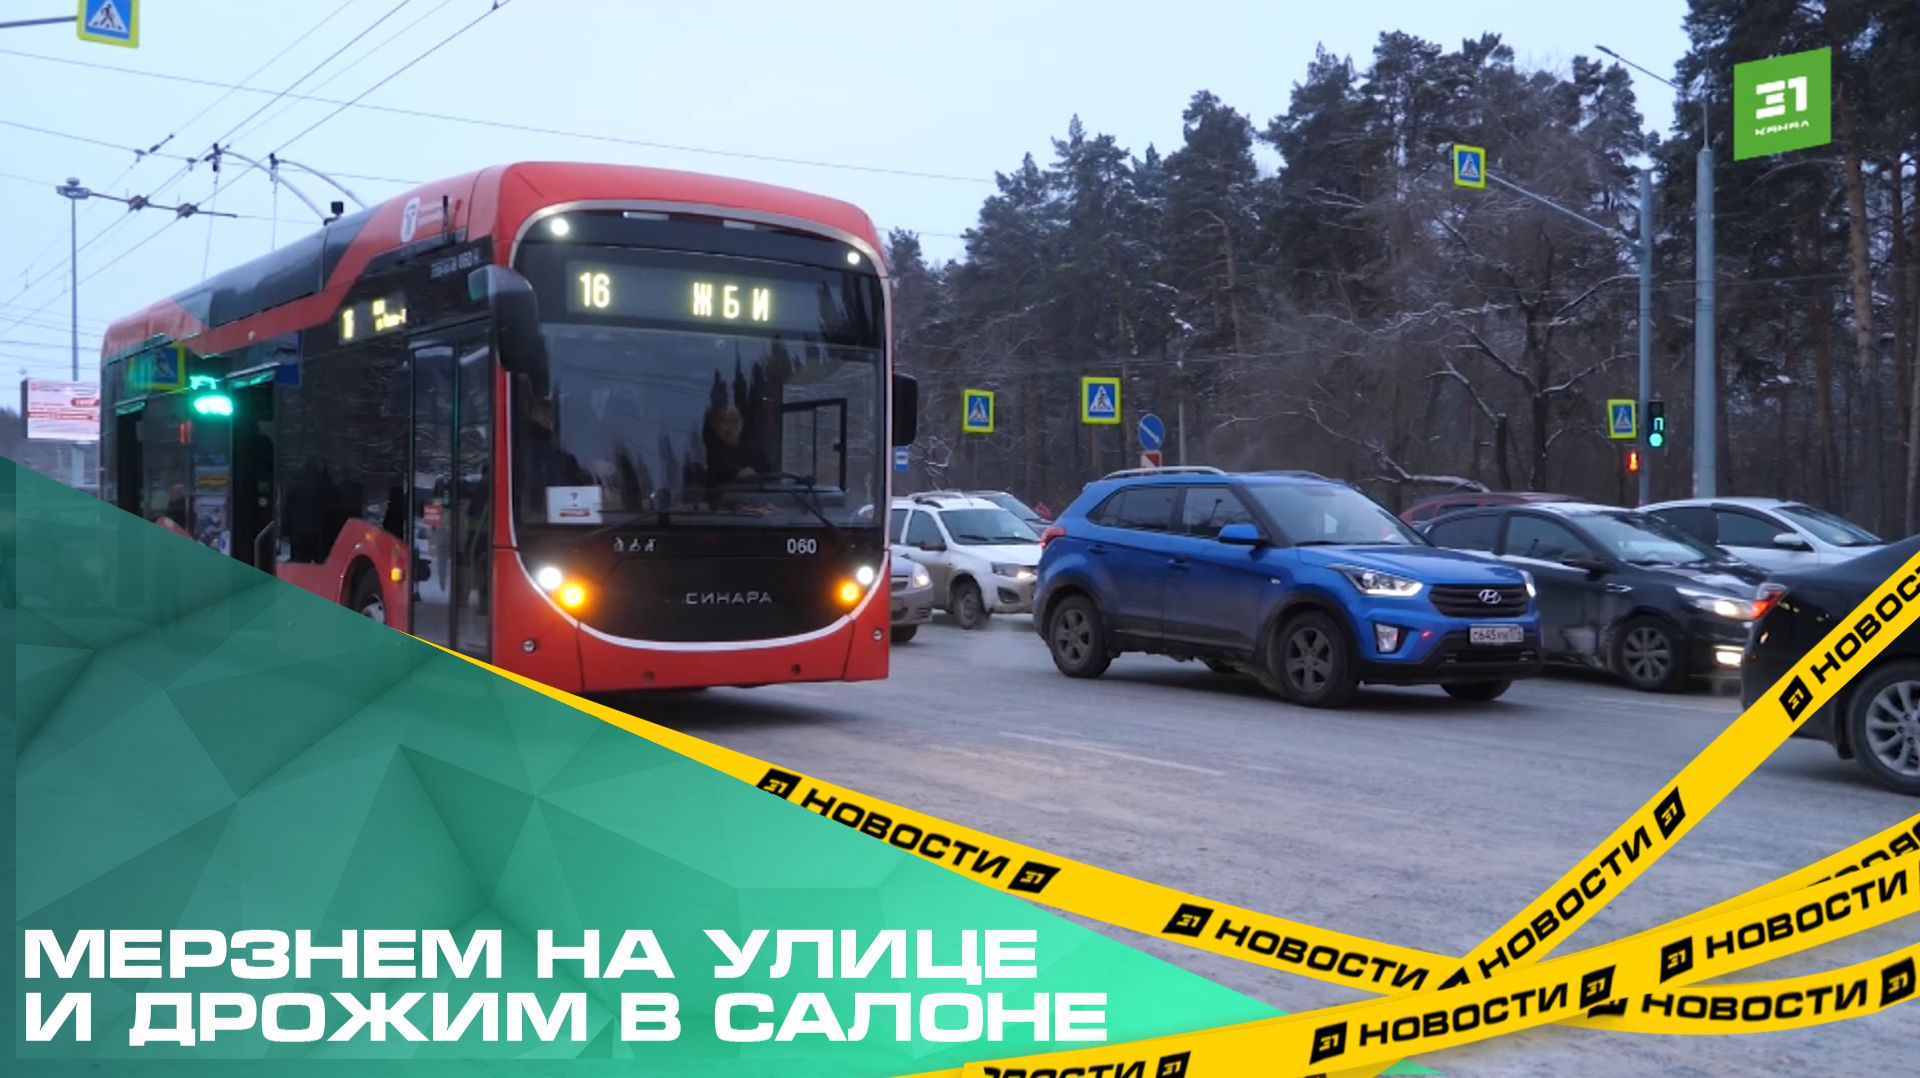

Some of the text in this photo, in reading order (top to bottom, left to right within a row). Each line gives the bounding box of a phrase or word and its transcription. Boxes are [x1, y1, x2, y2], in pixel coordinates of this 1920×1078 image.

[579, 271, 611, 309] 16
[786, 537, 818, 555] 060
[685, 590, 773, 606] СИНАРА
